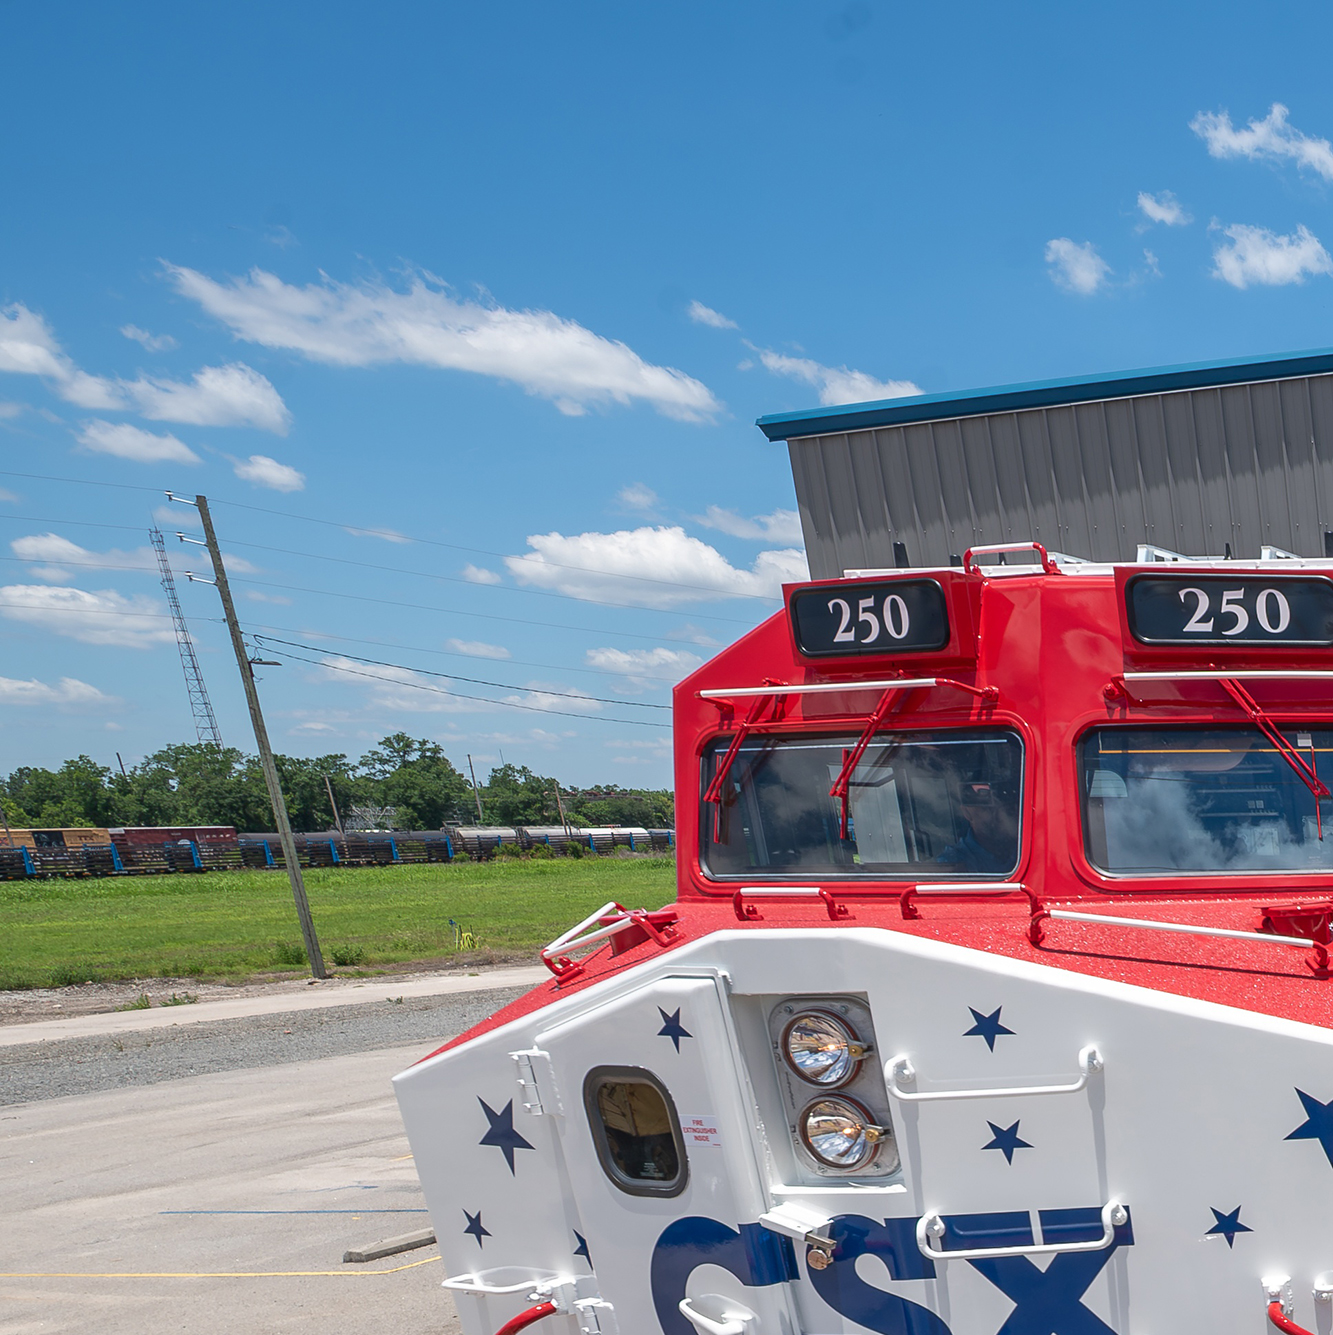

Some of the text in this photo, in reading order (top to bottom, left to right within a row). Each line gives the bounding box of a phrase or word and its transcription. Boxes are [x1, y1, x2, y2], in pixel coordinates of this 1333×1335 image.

[827, 593, 911, 644] 250
[1178, 587, 1291, 636] 250
[683, 1127, 718, 1135] EXTINGUISHER
[692, 1119, 704, 1127] FIRE
